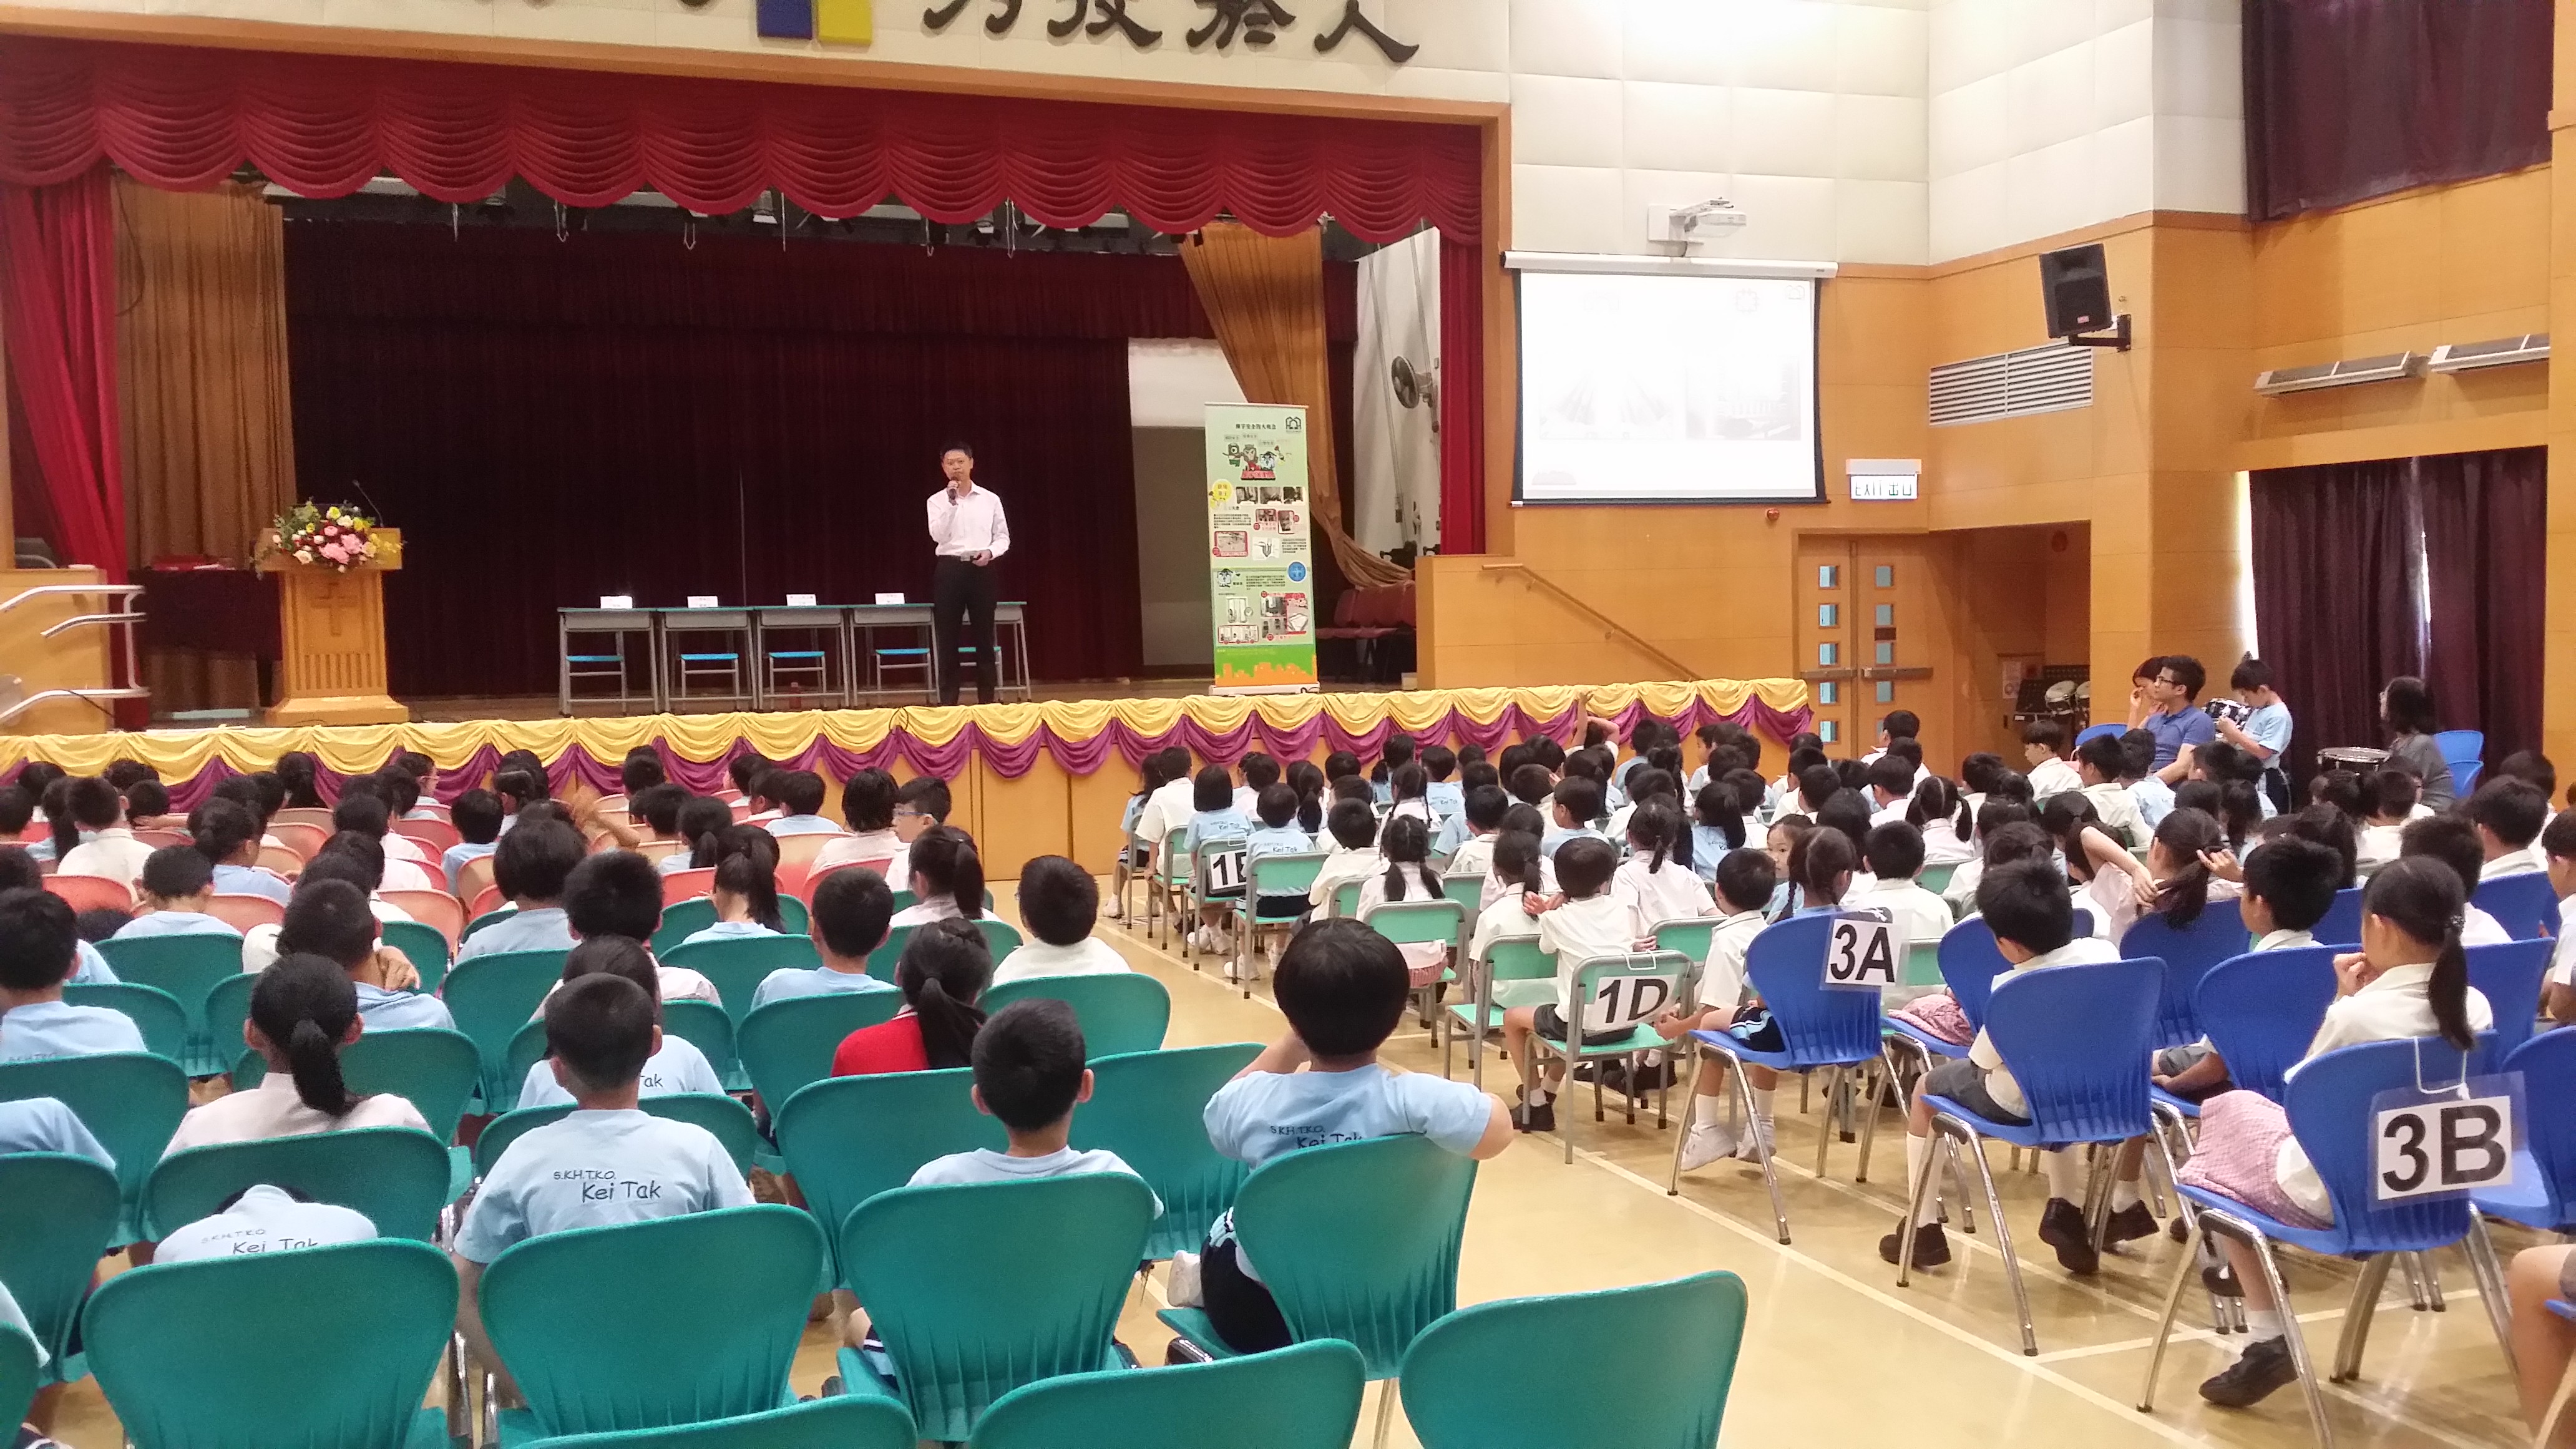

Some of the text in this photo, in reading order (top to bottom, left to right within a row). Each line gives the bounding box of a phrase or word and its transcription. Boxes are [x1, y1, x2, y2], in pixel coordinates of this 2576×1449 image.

[1855, 480, 1912, 496] EXIT 出口
[1830, 924, 1895, 982] 3A
[1599, 978, 1668, 1023] 1D
[2383, 1105, 2507, 1192] 3B
[582, 1179, 661, 1203] Kei Tak
[233, 1241, 266, 1254] Kei
